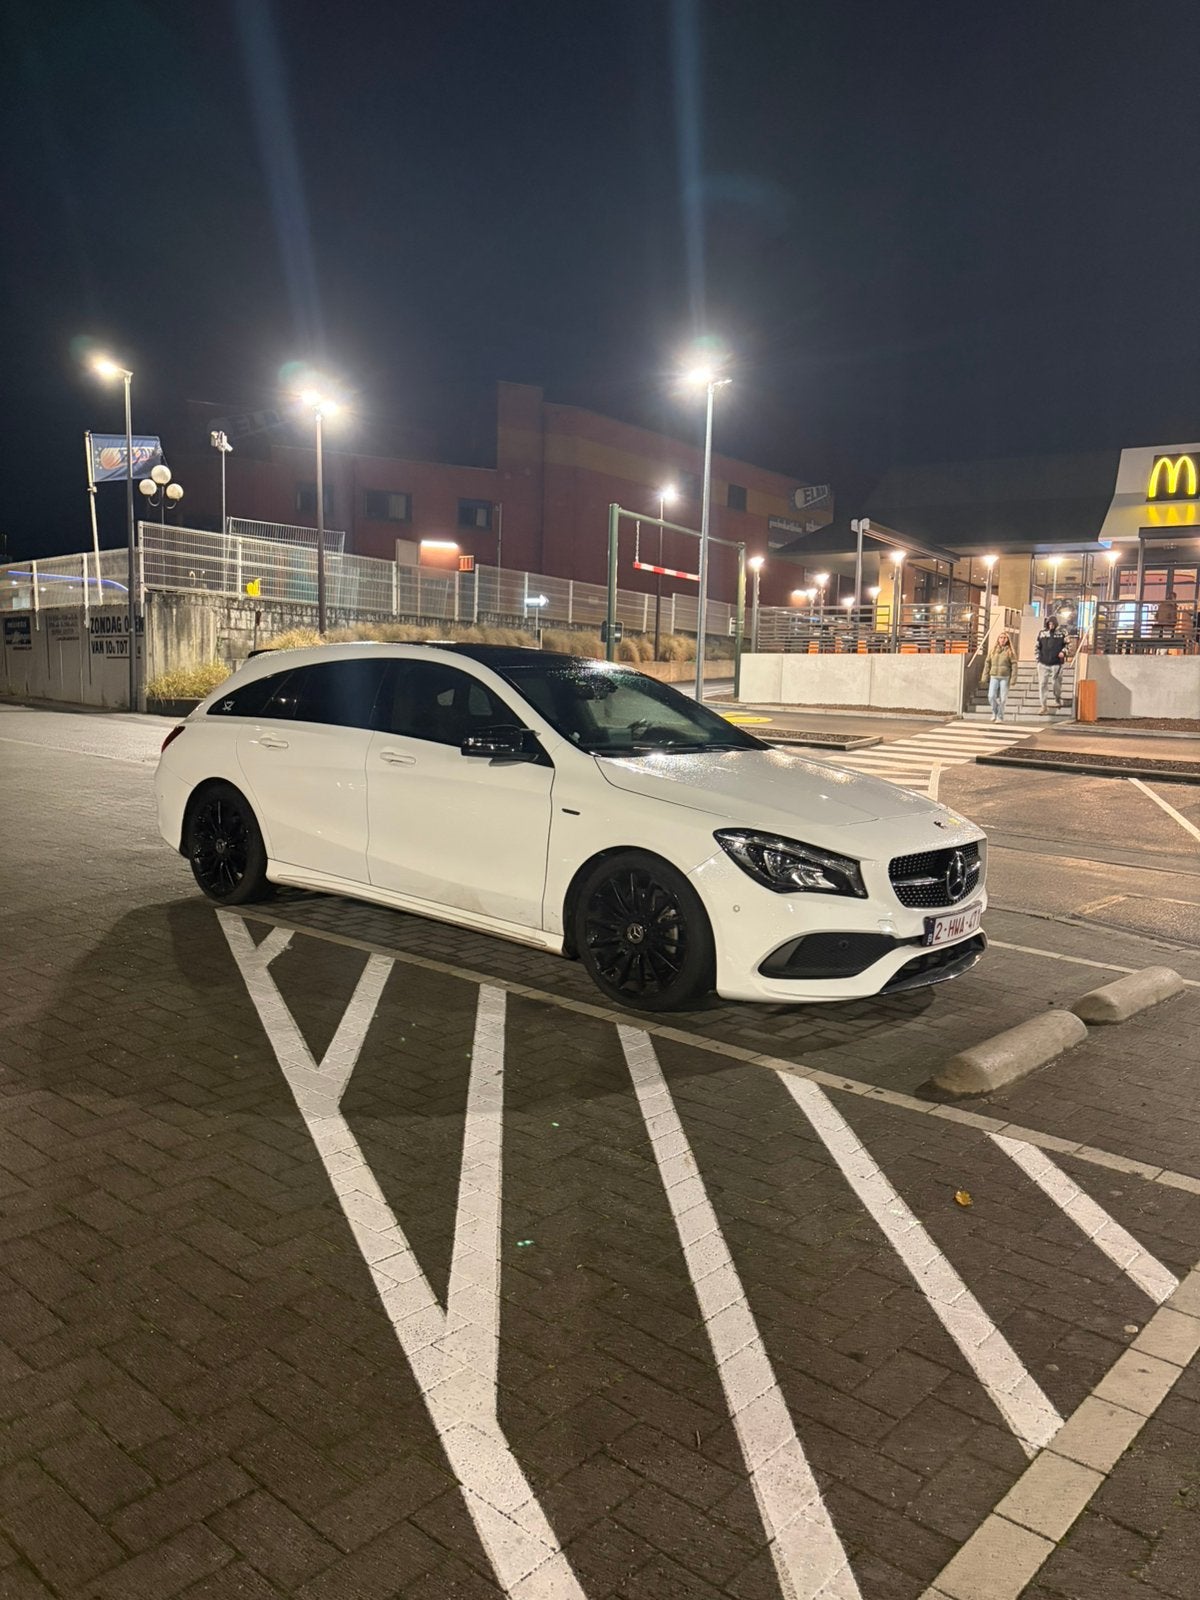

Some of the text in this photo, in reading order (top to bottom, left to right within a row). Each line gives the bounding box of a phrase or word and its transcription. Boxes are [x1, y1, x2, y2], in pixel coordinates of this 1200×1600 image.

[90, 615, 145, 634] ZONDAG OEN
[91, 640, 105, 654] VAN
[116, 640, 128, 654] TOT
